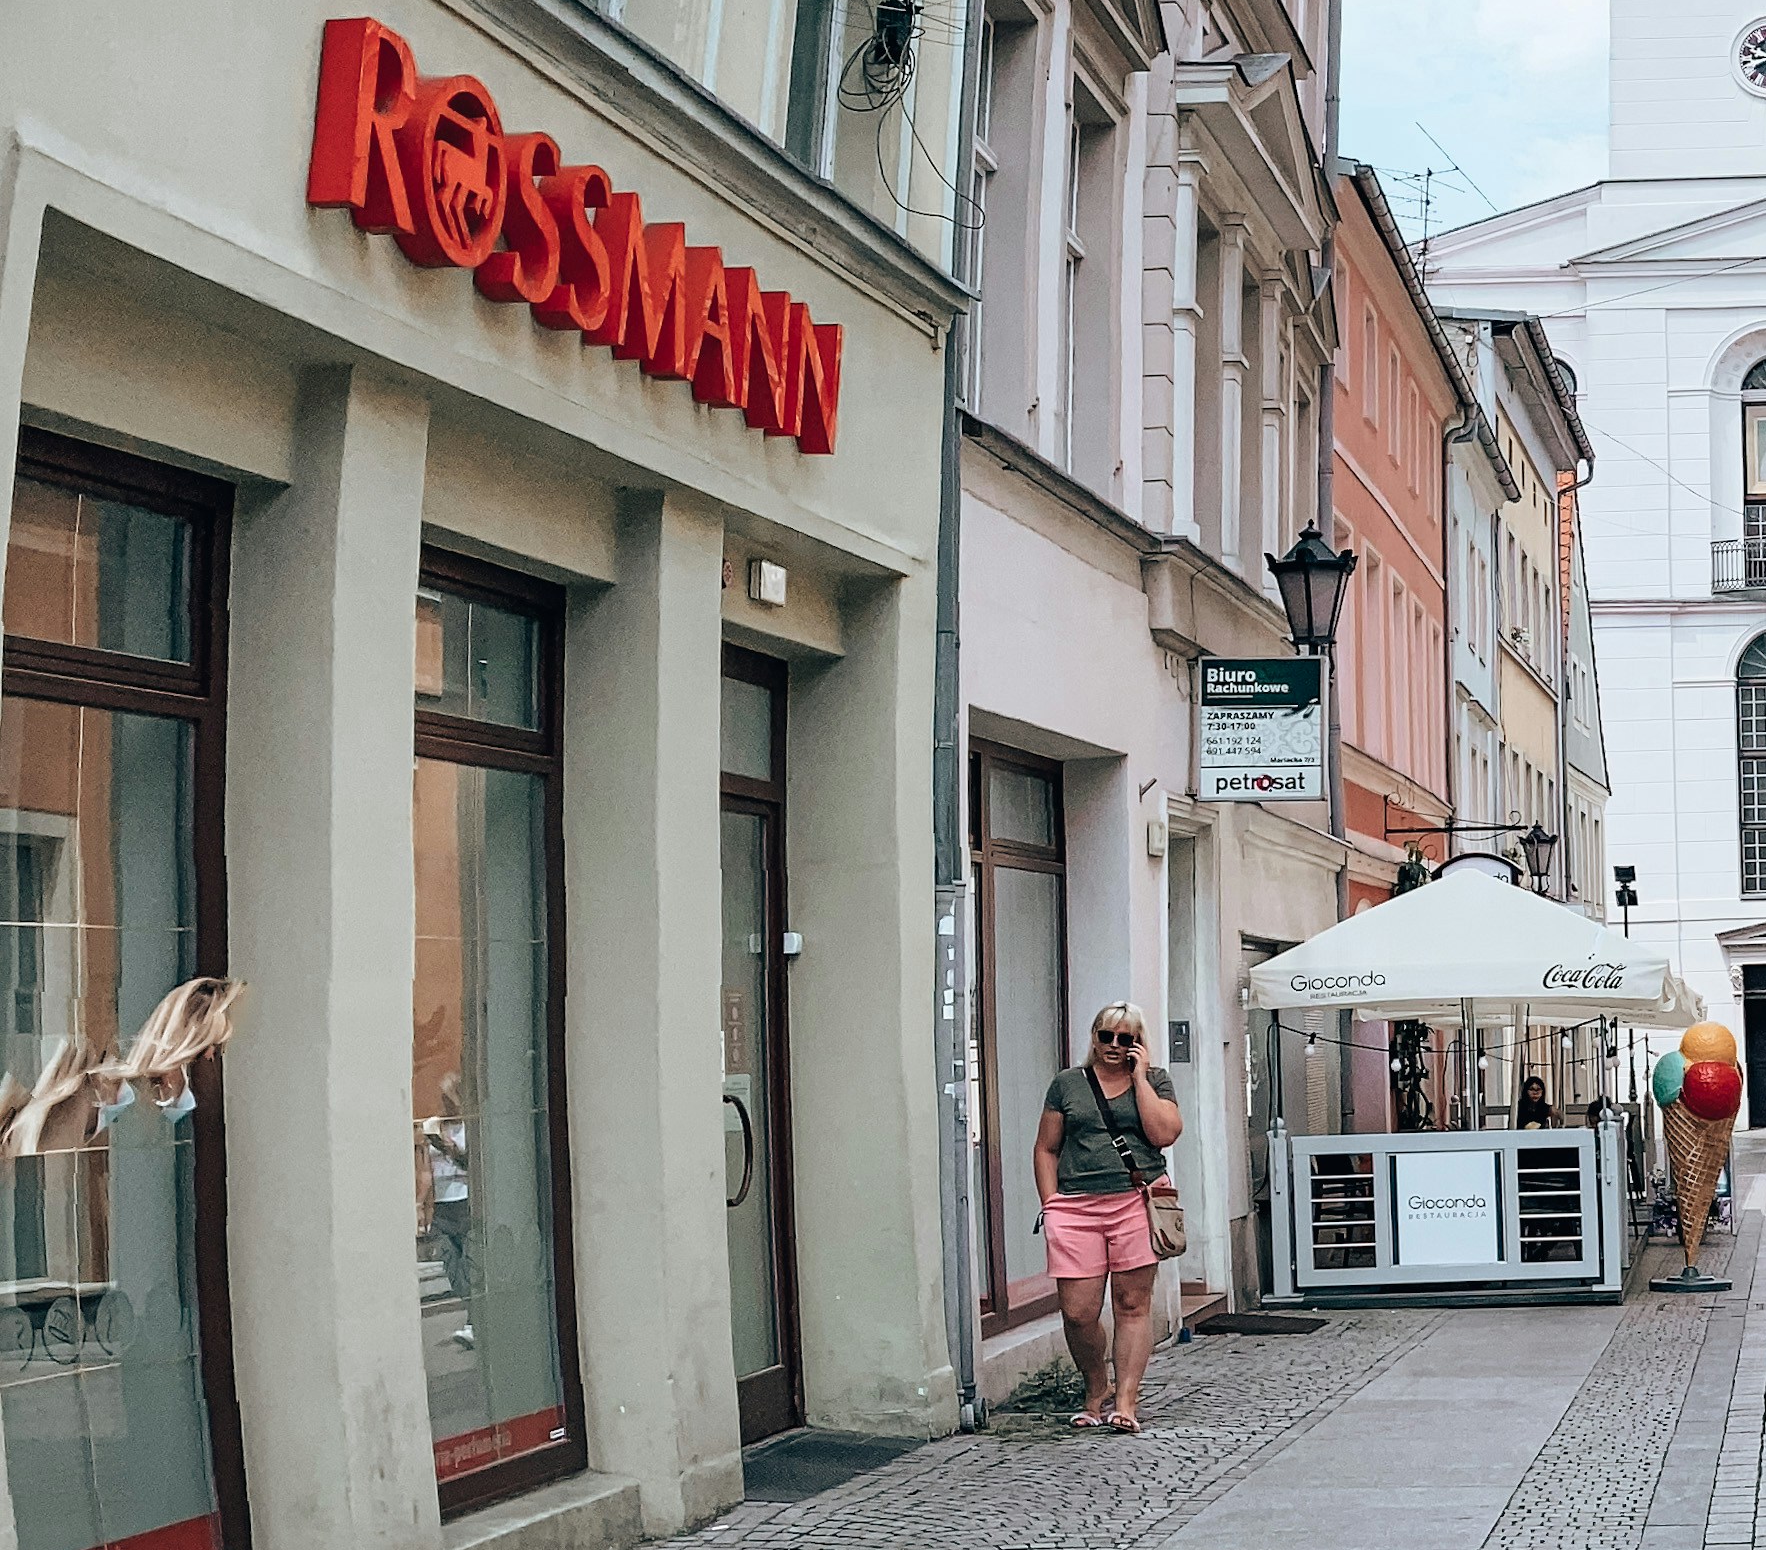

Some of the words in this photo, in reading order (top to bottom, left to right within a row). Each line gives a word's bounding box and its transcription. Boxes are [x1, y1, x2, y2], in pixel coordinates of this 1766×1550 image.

[306, 16, 843, 456] ROSSMANN
[1207, 667, 1257, 682] Biuro
[1206, 682, 1290, 694] Rachunkowe
[1207, 712, 1275, 720] ZAPRASZAMY
[1207, 722, 1256, 731] 7:30-17:00
[1246, 736, 1262, 745] 124
[1216, 772, 1305, 794] petrosat
[1290, 970, 1386, 992] Gioconda
[1542, 963, 1627, 990] Coca-Cola
[1408, 1194, 1486, 1210] Gioconda
[1408, 1211, 1487, 1220] RESTAURACJA
